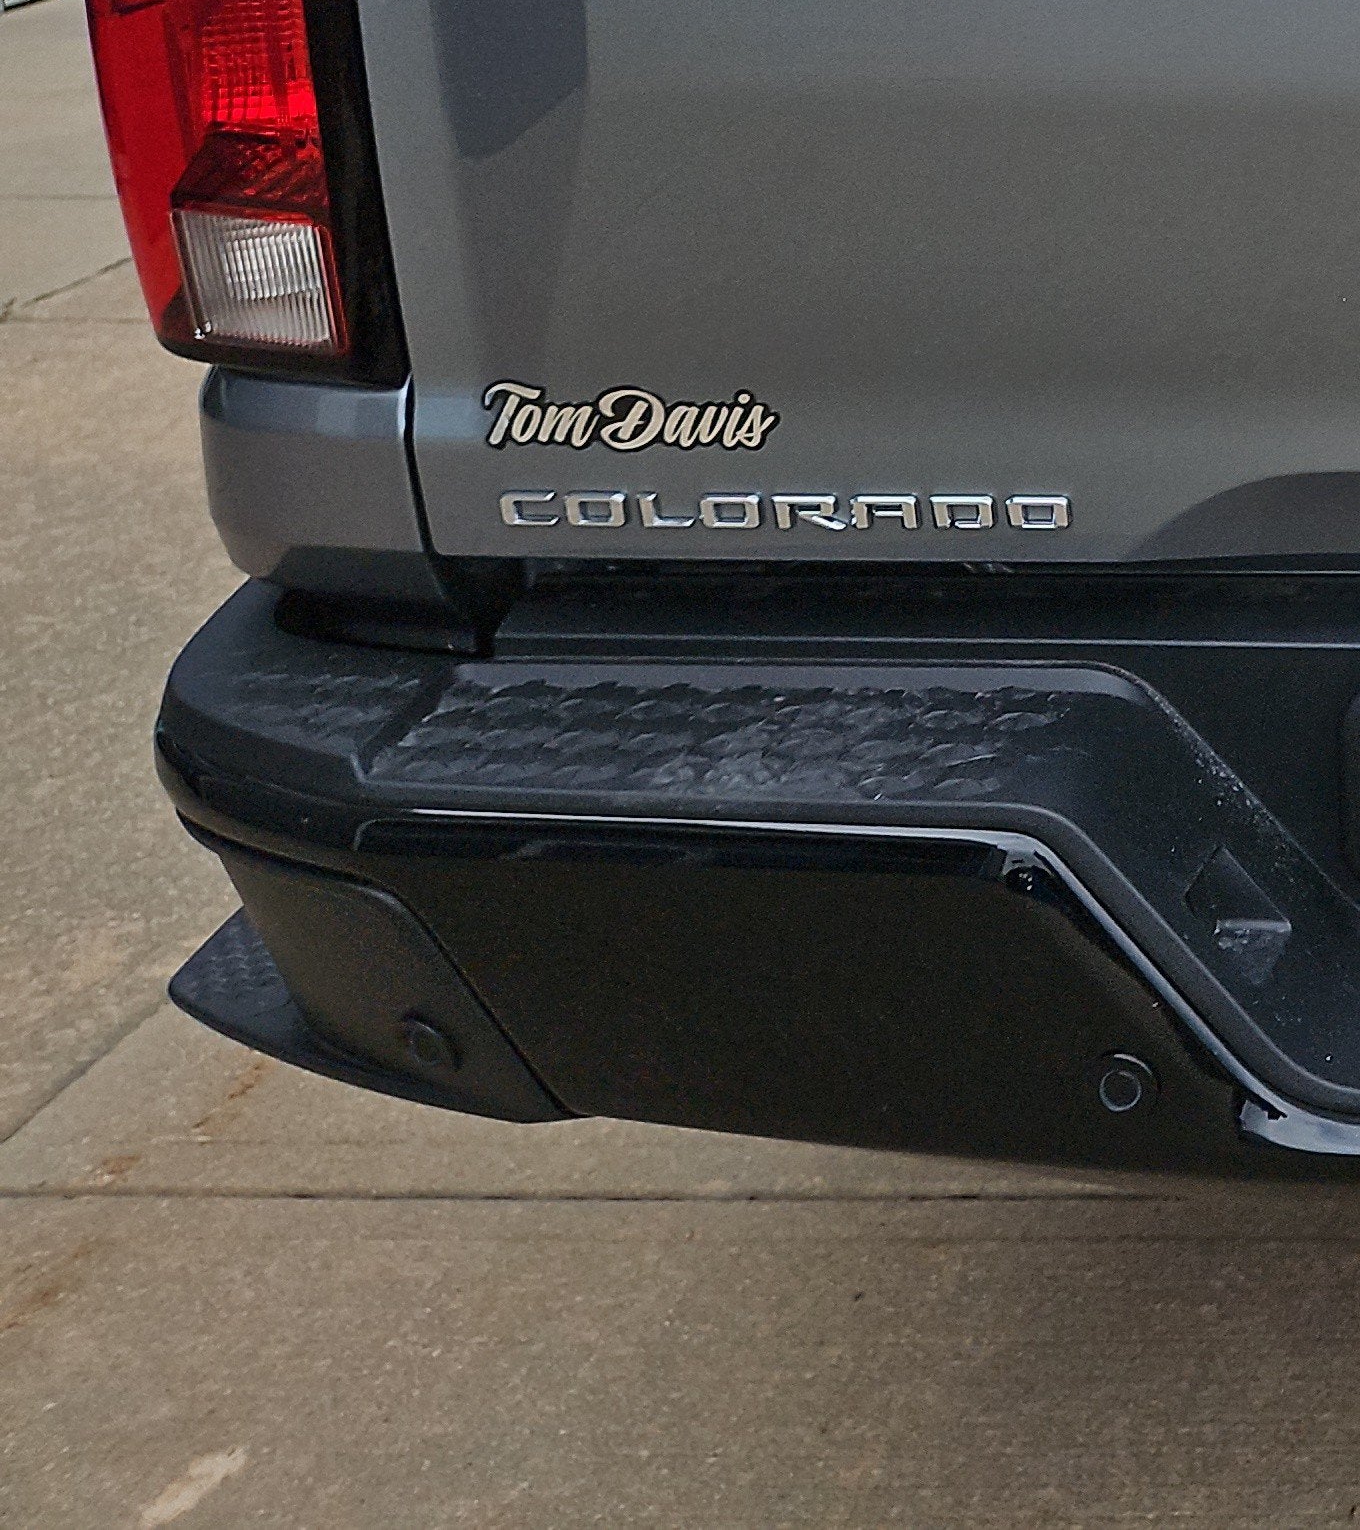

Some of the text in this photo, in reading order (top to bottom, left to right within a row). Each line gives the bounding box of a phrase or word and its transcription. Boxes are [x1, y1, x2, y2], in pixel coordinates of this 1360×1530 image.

[484, 381, 776, 450] Tom Davis
[498, 489, 1076, 532] COLORADO
